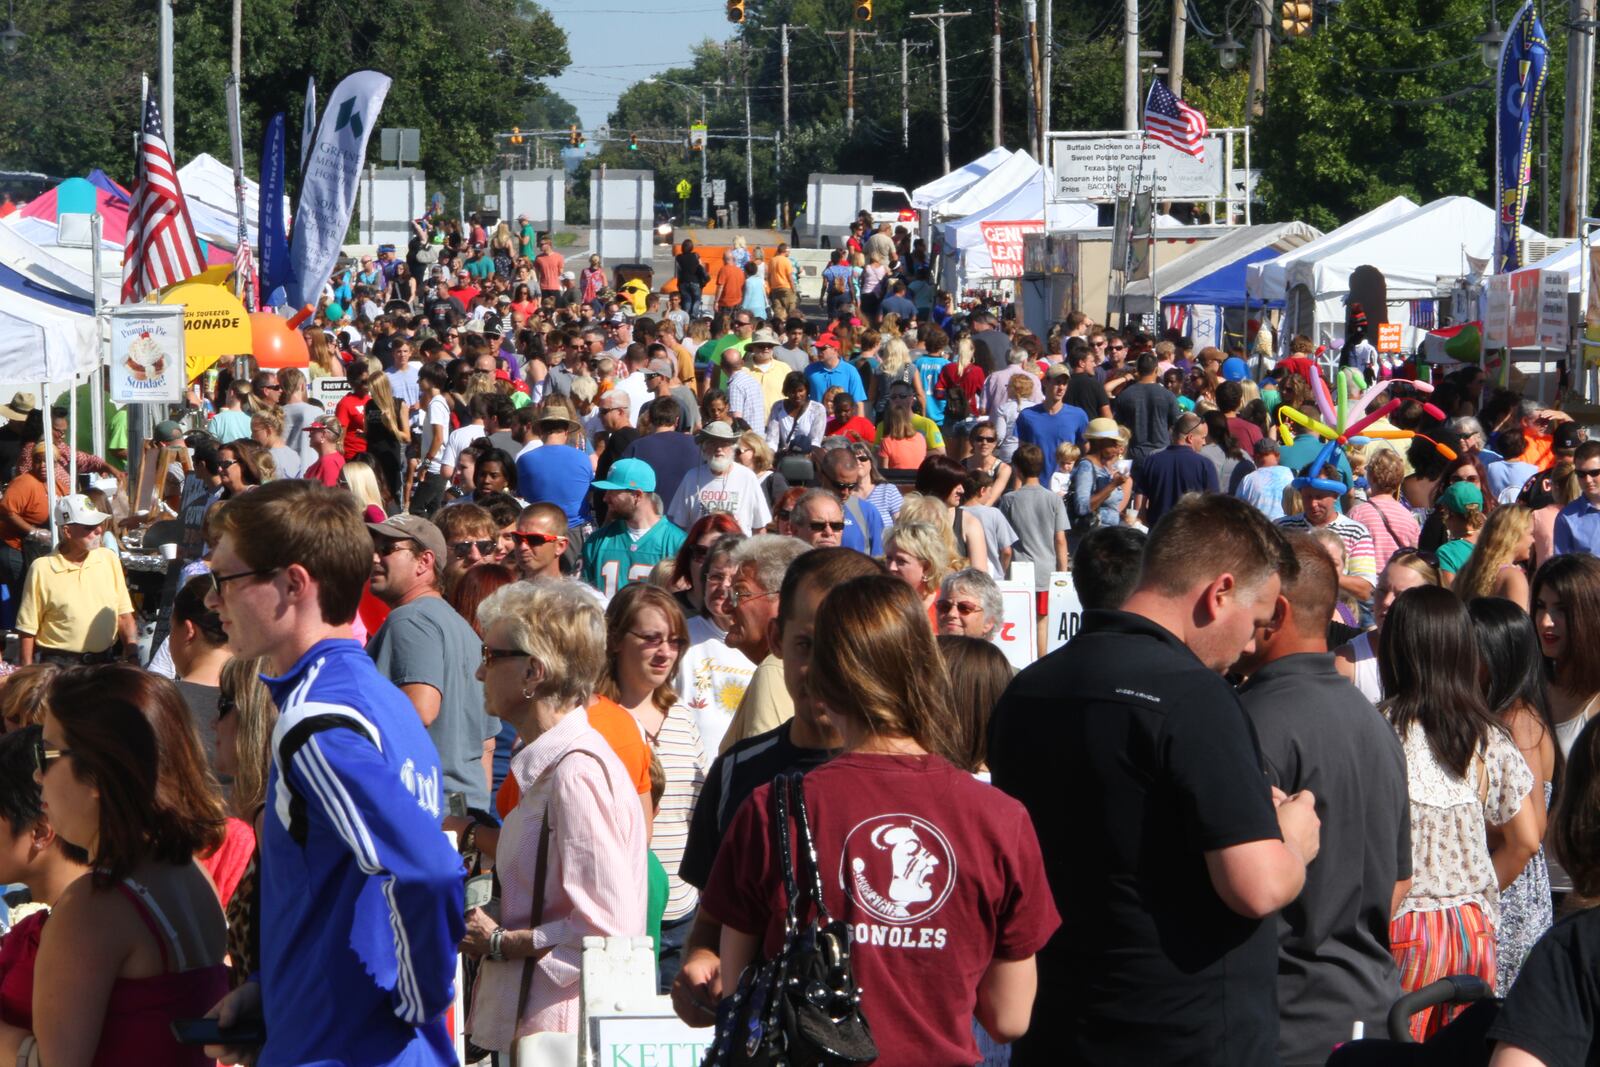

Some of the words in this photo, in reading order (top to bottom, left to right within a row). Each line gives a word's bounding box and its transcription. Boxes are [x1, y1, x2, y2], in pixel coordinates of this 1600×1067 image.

[1093, 143, 1122, 151] Chicken
[1107, 164, 1125, 172] Style
[1060, 175, 1090, 183] Sonoran
[196, 309, 230, 317] SQUEEZED
[120, 323, 154, 339] Pumpkin
[155, 325, 167, 336] Pie
[125, 375, 167, 390] Sundae!
[701, 490, 728, 501] GOOD
